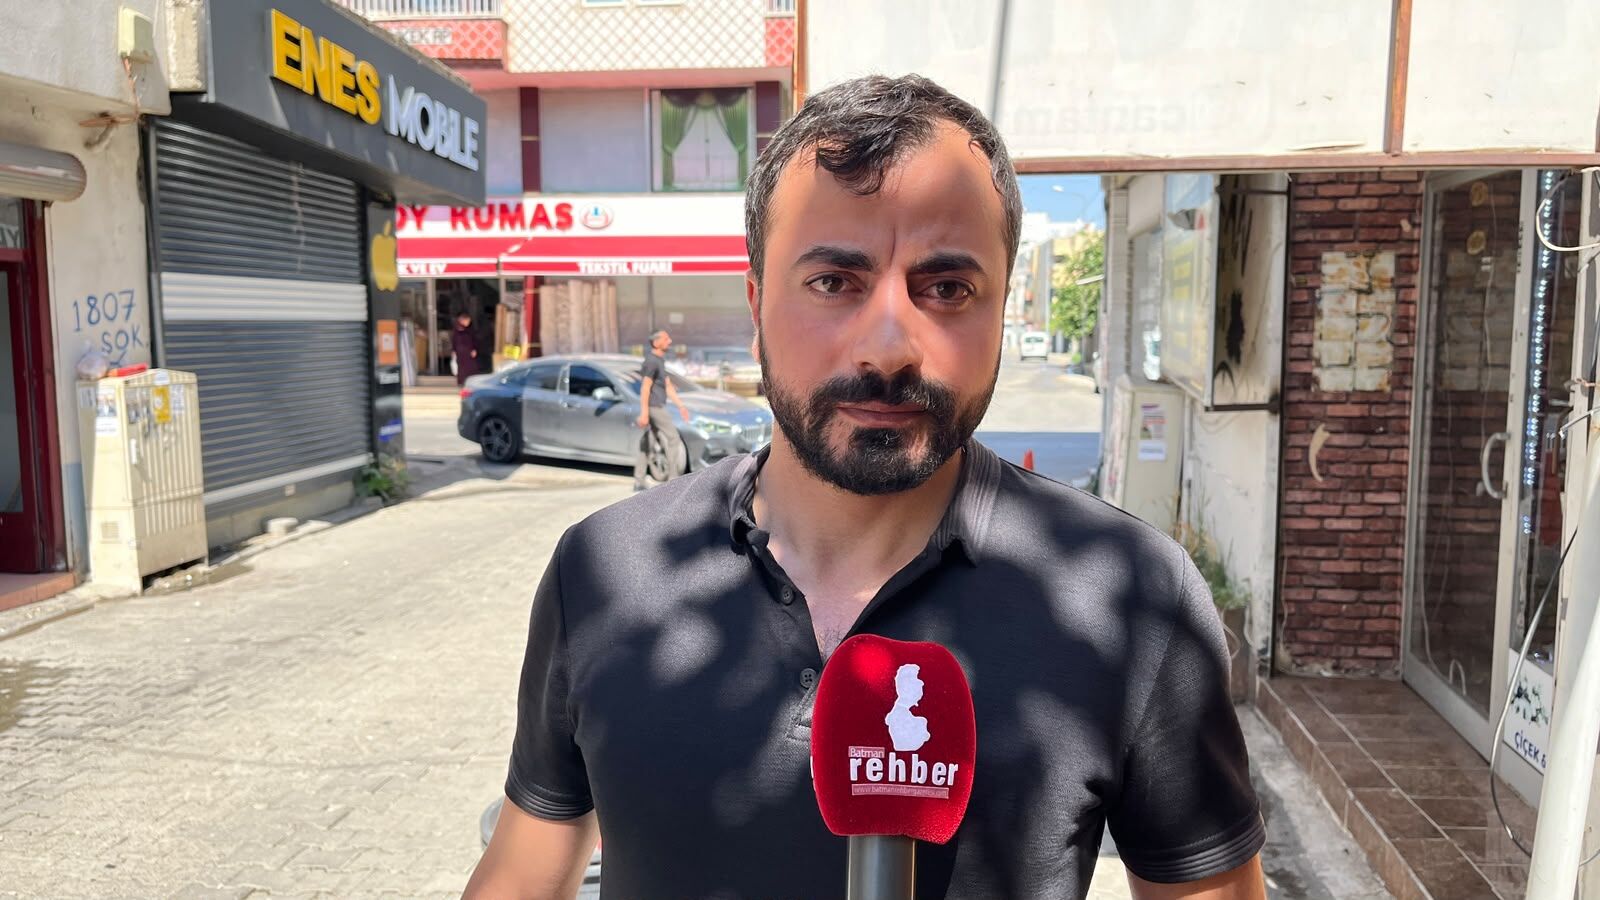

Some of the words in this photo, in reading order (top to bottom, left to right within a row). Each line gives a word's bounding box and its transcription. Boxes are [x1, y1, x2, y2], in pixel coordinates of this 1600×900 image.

[271, 8, 381, 125] ENES
[73, 288, 135, 333] 1807
[850, 747, 884, 759] Batman
[1514, 729, 1539, 764] ÇİÇEK
[849, 752, 959, 786] rehber
